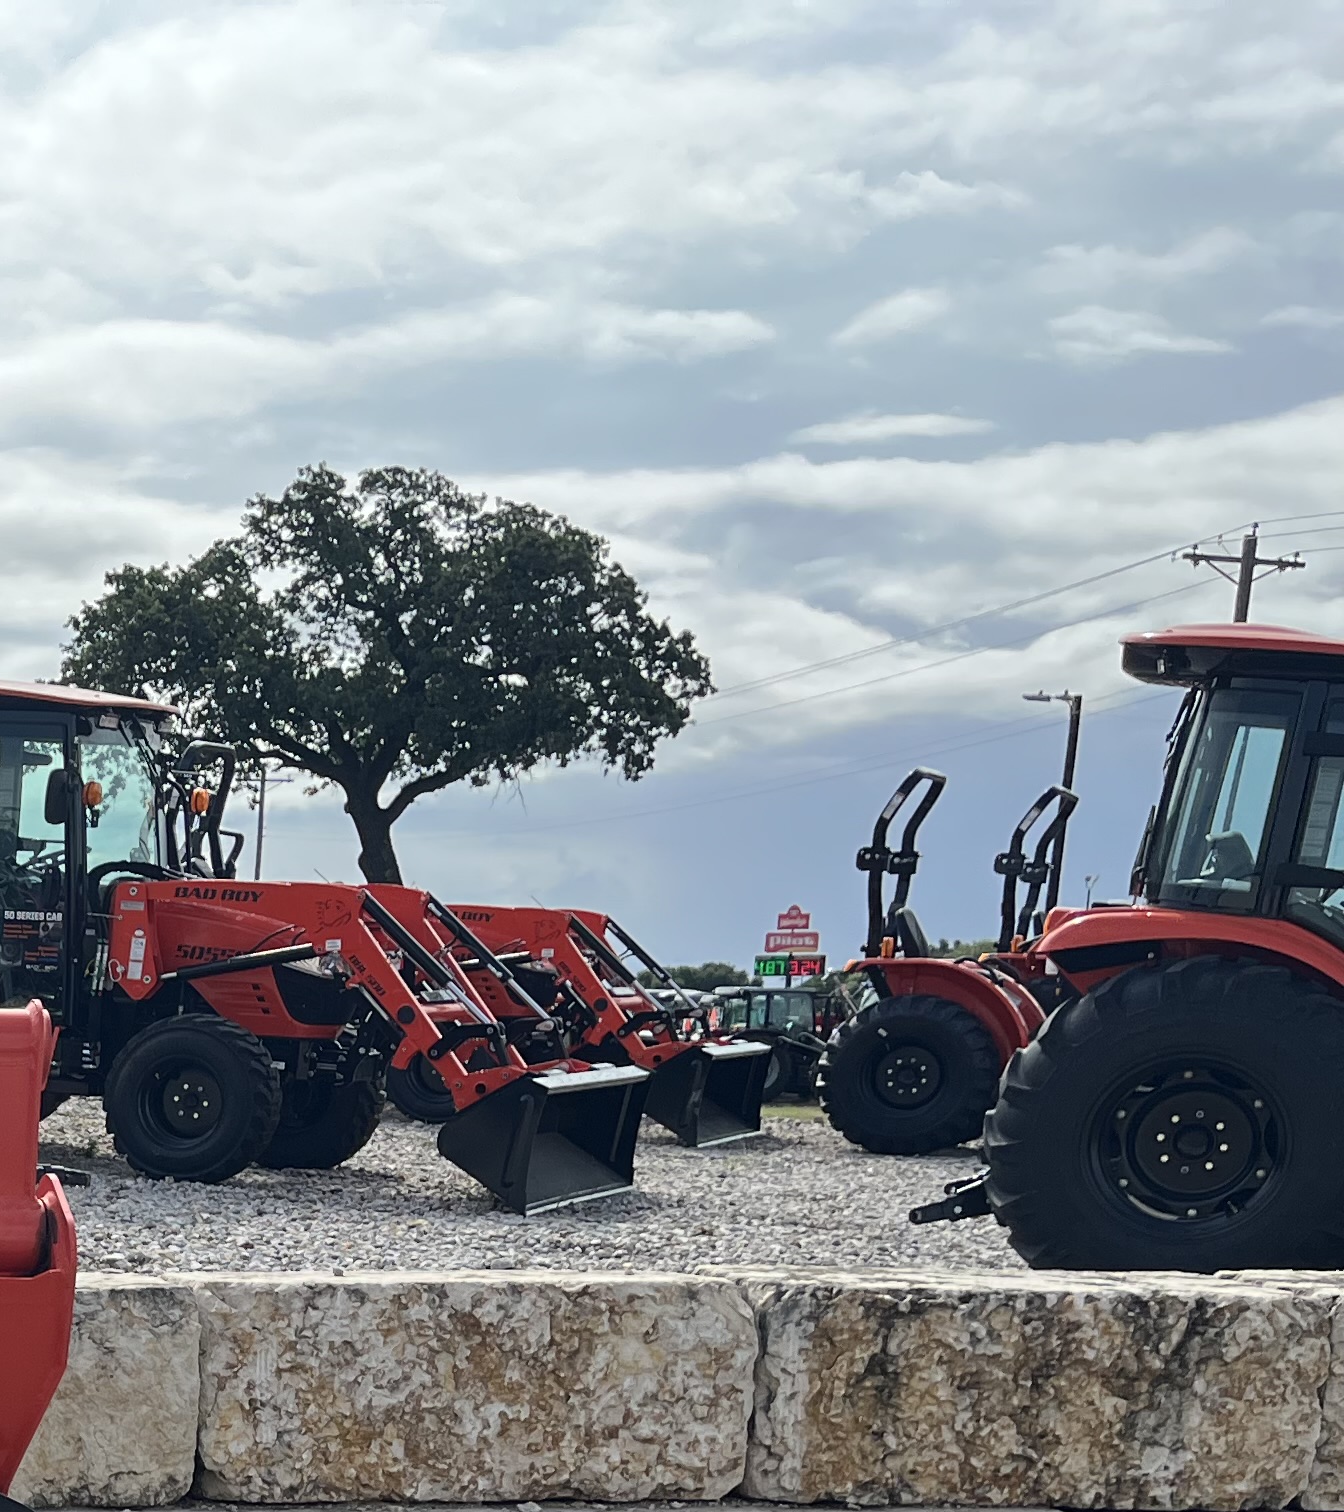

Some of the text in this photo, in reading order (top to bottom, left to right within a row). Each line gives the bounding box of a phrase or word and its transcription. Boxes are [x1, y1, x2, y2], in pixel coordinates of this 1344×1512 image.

[174, 886, 265, 903] BAD BOY
[3, 910, 63, 922] 50 SERIES CAB
